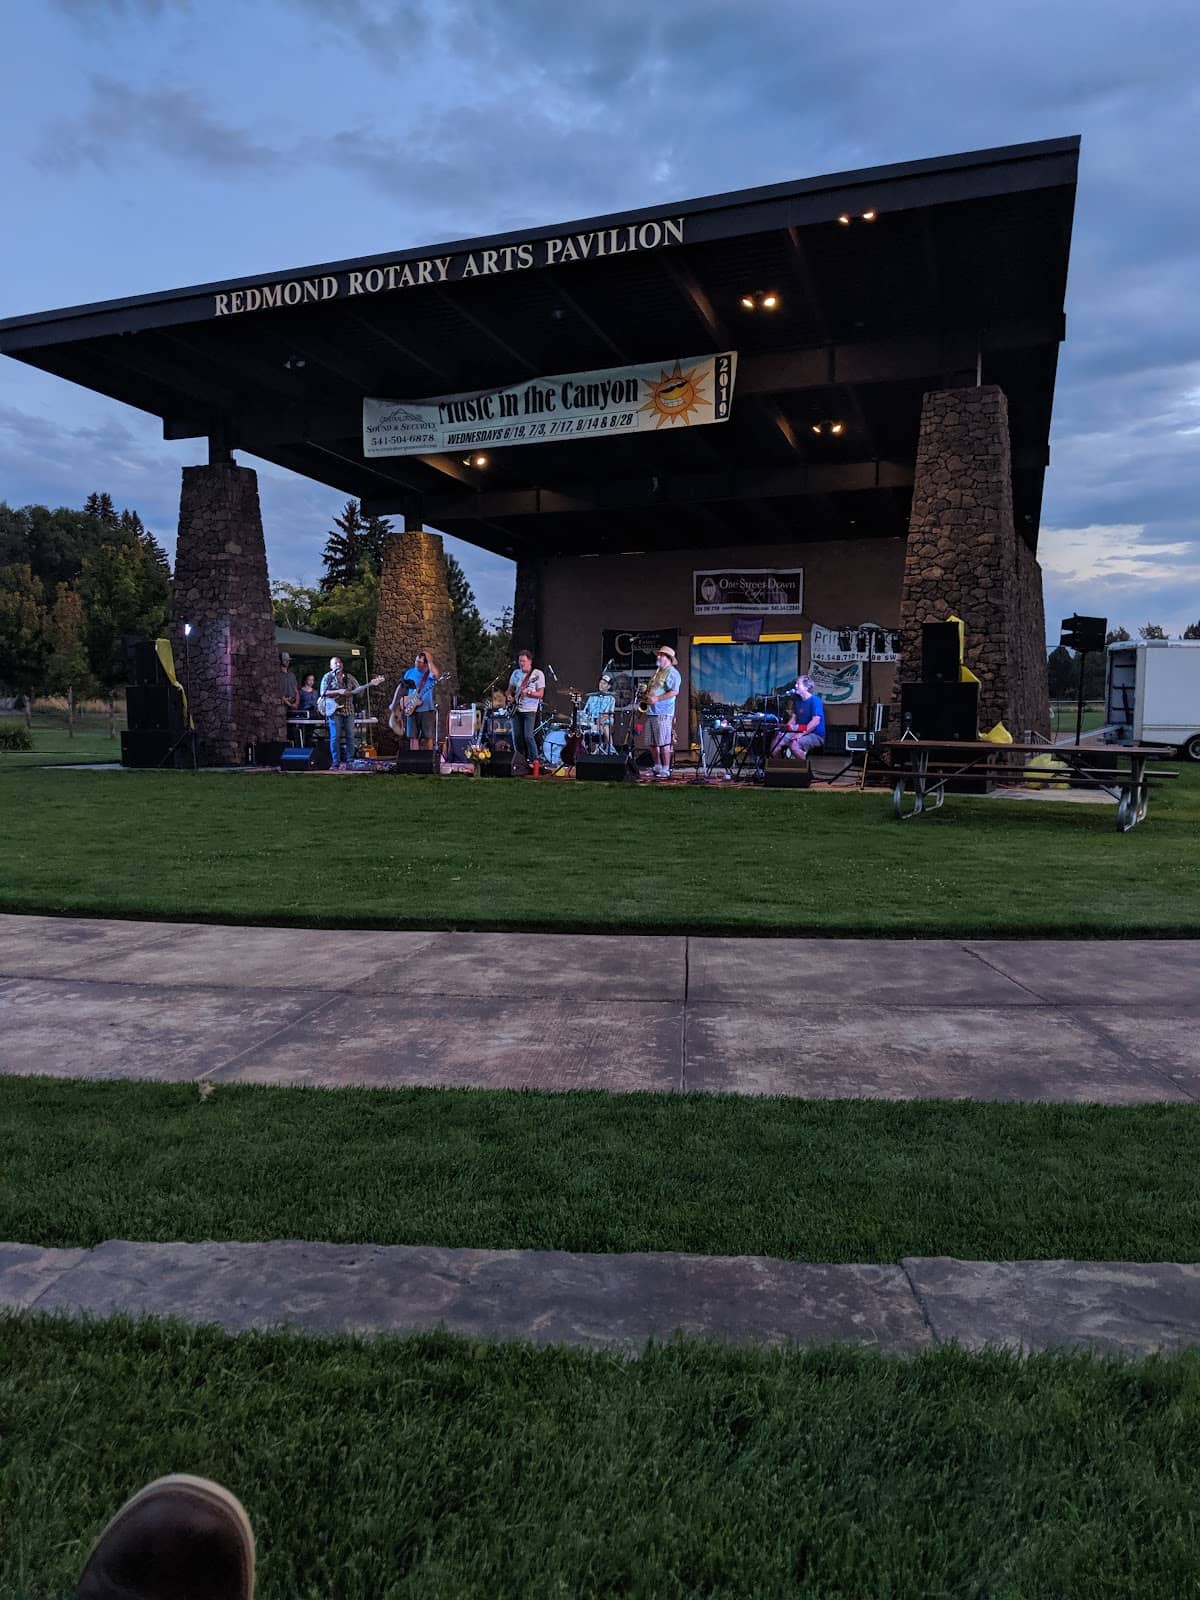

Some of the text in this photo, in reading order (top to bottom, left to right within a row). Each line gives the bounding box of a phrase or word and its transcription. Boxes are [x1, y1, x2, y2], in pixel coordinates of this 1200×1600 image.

[214, 218, 685, 317] REDMOND ROTARY ARTS PAVILION
[438, 378, 638, 425] Music in the Canyon
[719, 358, 728, 416] 2019
[447, 413, 633, 446] WEDNESDAYS 6/19, 7/3, 7/17, 8/14 & 8/28
[768, 578, 796, 590] Down
